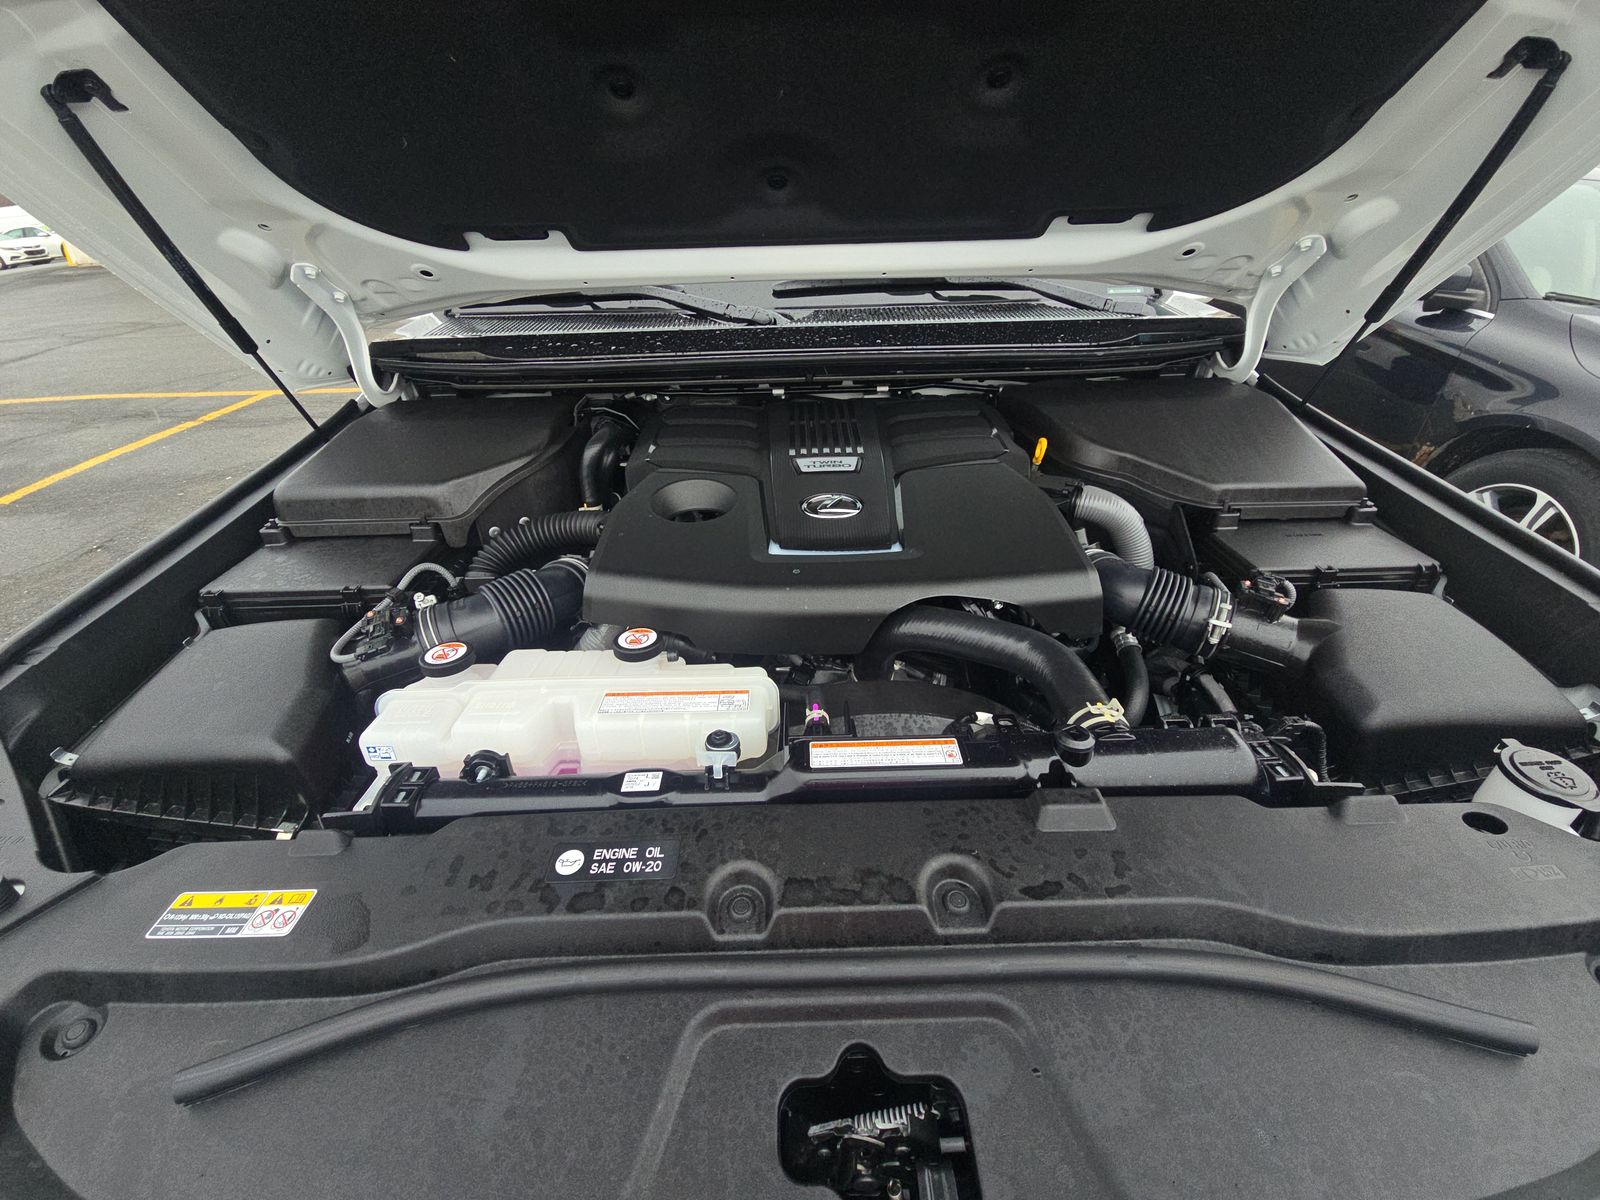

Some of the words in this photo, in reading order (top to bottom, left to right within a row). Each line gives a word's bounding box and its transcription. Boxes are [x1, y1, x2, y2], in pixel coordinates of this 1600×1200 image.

[593, 847, 638, 860] ENGINE
[645, 847, 664, 858] OIL
[589, 862, 616, 874] SAE
[623, 860, 662, 873] 0W-20
